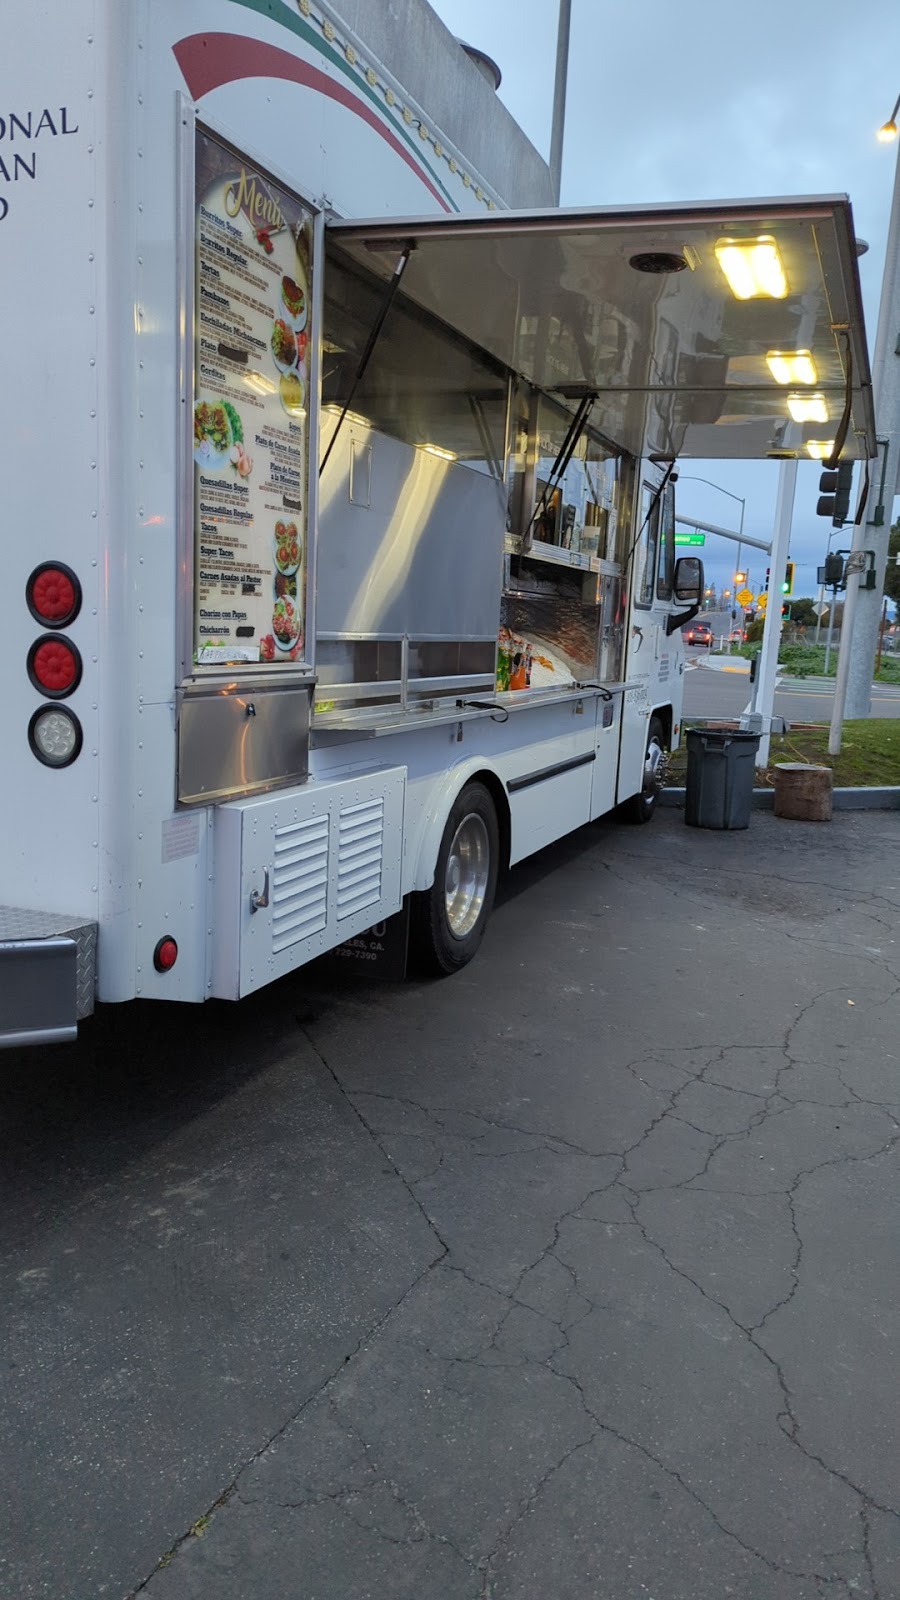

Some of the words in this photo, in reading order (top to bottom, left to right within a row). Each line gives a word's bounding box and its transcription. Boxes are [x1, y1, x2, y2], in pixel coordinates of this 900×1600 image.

[0, 107, 79, 141] NAL
[201, 205, 225, 228] Burritos
[226, 221, 243, 238] Super
[201, 232, 225, 254] Burritos
[226, 246, 248, 266] Regular
[200, 260, 220, 278] Tortas
[200, 285, 230, 307] Pambazos
[200, 312, 233, 334] Enchiladas
[200, 337, 217, 351] Plato
[200, 364, 226, 381] Gorditas
[255, 435, 268, 446] Plato
[268, 439, 274, 448] de
[274, 441, 287, 452] Carne
[270, 461, 282, 472] Plato
[282, 465, 288, 473] de
[288, 468, 301, 477] Carne
[275, 473, 280, 481] la
[200, 476, 232, 490] Quesadillas
[234, 483, 249, 494] Super
[200, 503, 232, 516] Quesadillas
[234, 509, 254, 520] Regular
[201, 522, 218, 532] Tacos
[200, 545, 218, 557] Super
[219, 548, 234, 557] Tacos
[200, 571, 220, 580] Carnes
[220, 573, 240, 582] Asadas
[246, 575, 262, 583] Pastor
[200, 609, 221, 618] Chorizo
[232, 610, 247, 620] Papas
[344, 939, 368, 951] LES,
[369, 941, 385, 951] CA.
